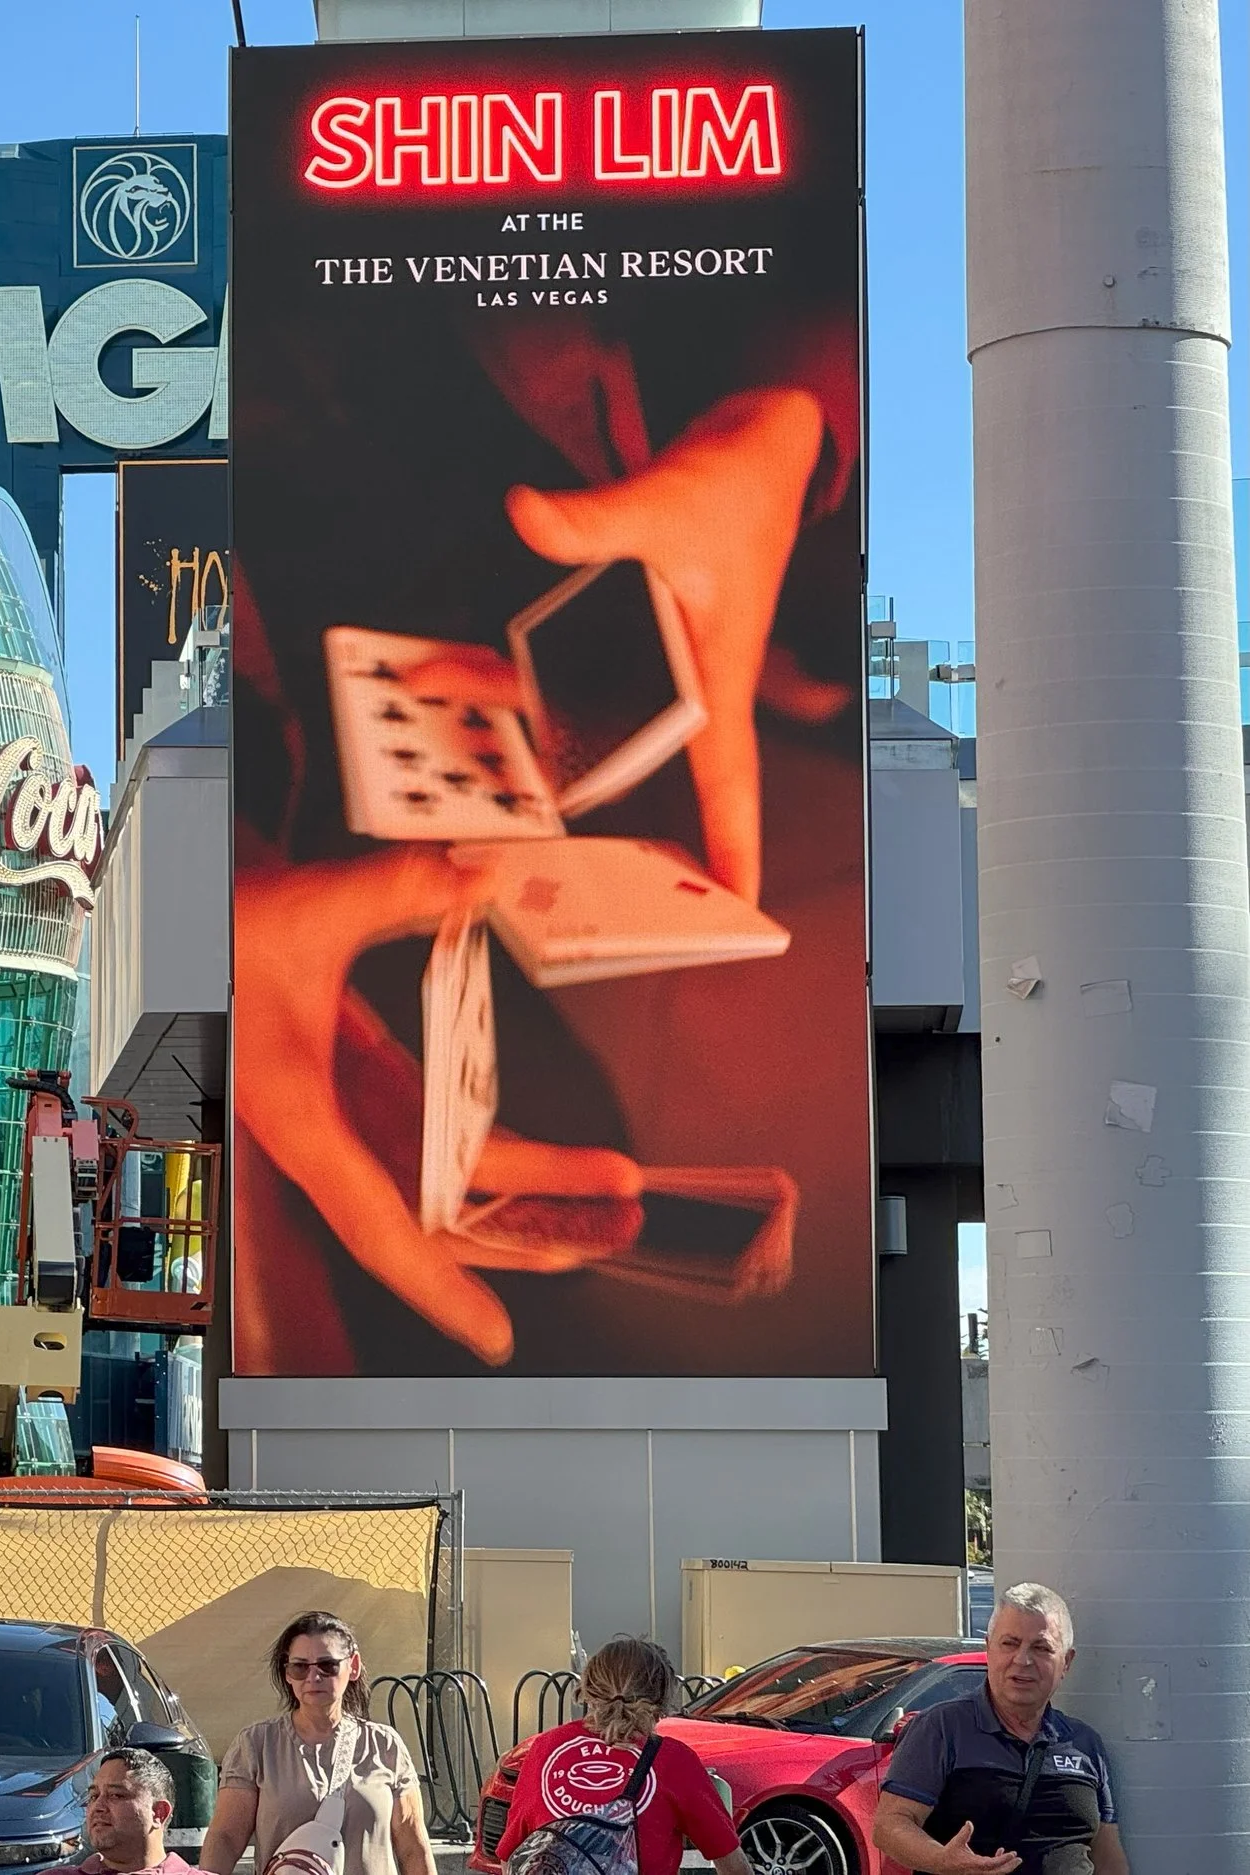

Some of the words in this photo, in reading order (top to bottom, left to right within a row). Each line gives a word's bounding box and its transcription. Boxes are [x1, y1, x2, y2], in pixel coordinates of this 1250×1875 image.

[304, 92, 563, 188] SHIN
[593, 85, 782, 180] LIM
[500, 214, 530, 232] AT
[537, 212, 584, 231] THE
[315, 257, 394, 285] THE
[406, 252, 608, 283] VENETIAN
[620, 247, 774, 279] RESORT
[477, 291, 518, 308] LAS
[531, 289, 609, 307] VEGAS
[710, 1559, 748, 1571] 800142
[580, 1744, 612, 1757] EAT
[1053, 1755, 1082, 1769] EA7
[553, 1769, 565, 1779] 19
